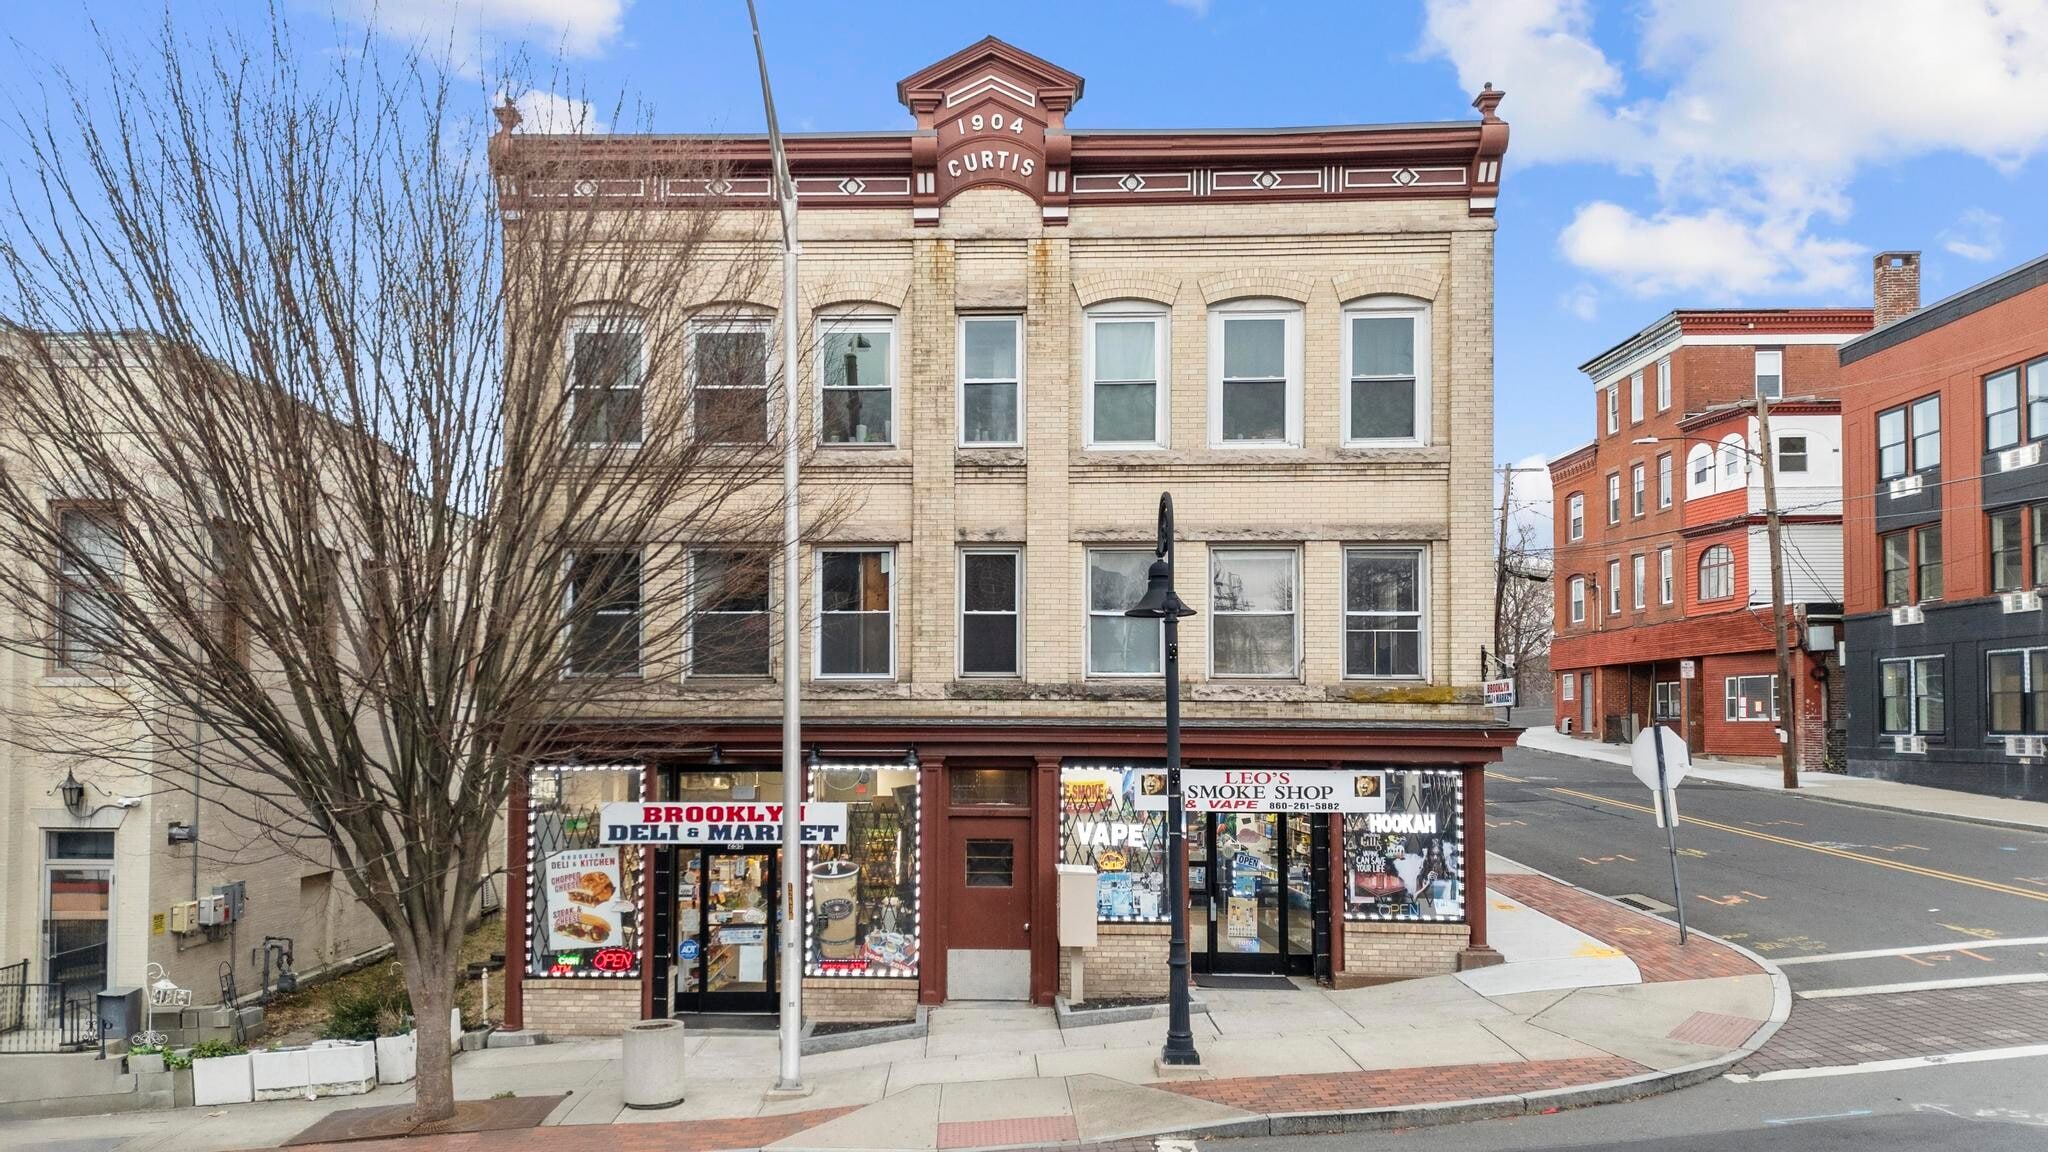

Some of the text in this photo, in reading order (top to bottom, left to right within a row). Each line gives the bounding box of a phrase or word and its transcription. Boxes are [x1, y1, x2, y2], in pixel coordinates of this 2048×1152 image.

[957, 113, 1024, 135] 1904
[947, 150, 1035, 177] CURTIS
[1224, 771, 1290, 785] LEO'S
[1072, 783, 1104, 800] SMOKE
[1187, 785, 1333, 800] SMOKE SHOP
[1185, 800, 1340, 810] & VAPE 860-261-5882
[643, 806, 805, 823] BROOKLY
[1369, 813, 1436, 834] HOOKAH
[608, 824, 679, 841] DELI
[687, 827, 699, 838] &
[1077, 821, 1145, 849] VAPE
[551, 861, 569, 869] DELI
[580, 858, 616, 868] KITCHEN
[1239, 855, 1259, 866] OPEN
[1356, 856, 1386, 865] CAN SAVE
[1356, 864, 1386, 873] YOUR LIFE
[551, 872, 581, 885] CHOPPED
[552, 908, 577, 920] STEAK
[1378, 903, 1420, 917] OPEN
[681, 945, 696, 953] ADT
[594, 953, 632, 968] OPEN
[550, 965, 572, 973] ATM
